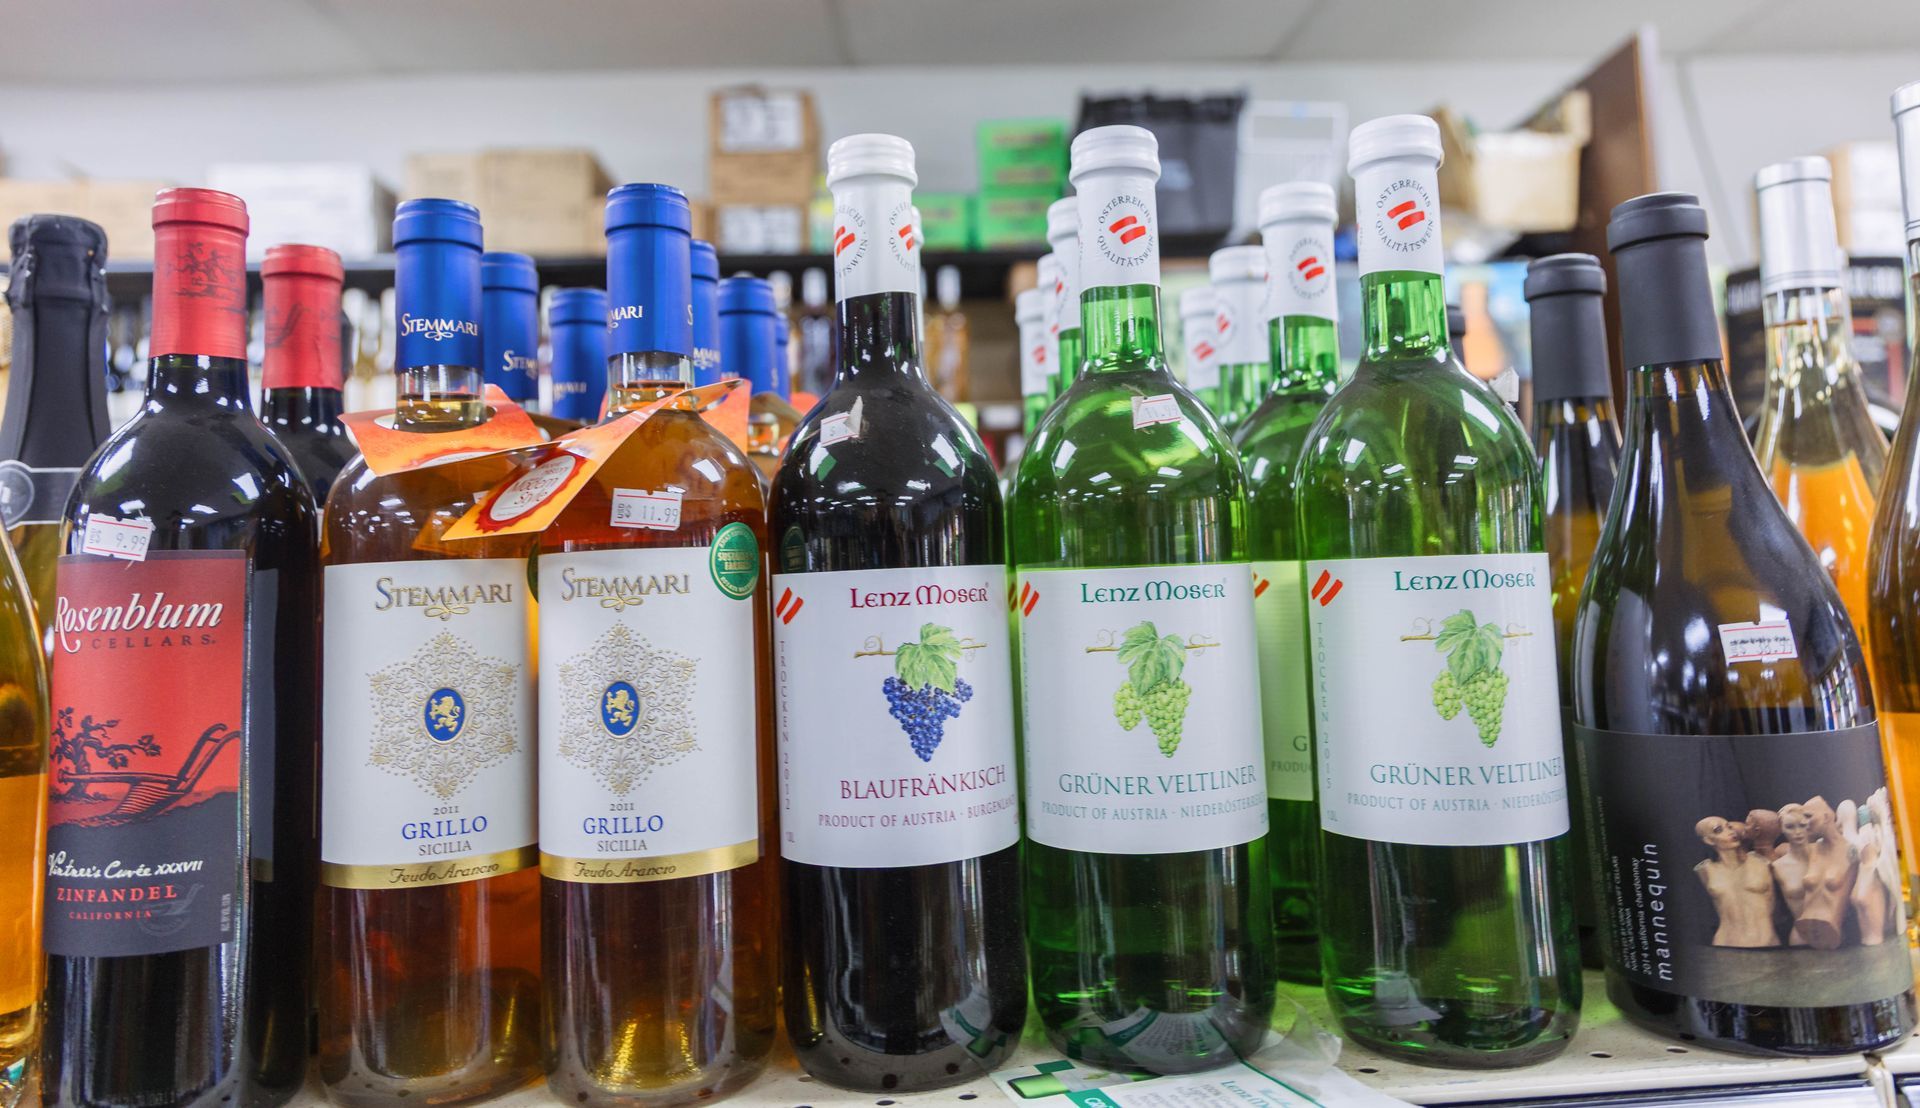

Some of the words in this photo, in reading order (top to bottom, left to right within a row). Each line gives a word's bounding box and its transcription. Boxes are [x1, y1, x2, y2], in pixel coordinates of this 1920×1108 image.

[642, 506, 679, 524] 11.99
[116, 532, 147, 552] 9.99
[375, 576, 513, 620] STEMMARI
[561, 567, 691, 611] STEMMARI
[54, 592, 224, 653] Rosenblum
[840, 765, 1006, 799] BLAUFRÄNKISCH
[1058, 772, 1154, 795] GRÜNER
[1158, 765, 1257, 794] VELTLINER
[1370, 763, 1475, 786] GRÜNER
[432, 806, 460, 815] 2011
[609, 803, 635, 811] 2011
[1041, 801, 1087, 819] PRODUCT
[1092, 807, 1108, 820] OF
[1112, 808, 1168, 820] AUSTRIA
[1347, 793, 1404, 810] PRODUCT
[1409, 798, 1427, 811] OF
[1433, 798, 1490, 812] AUSTRIA
[402, 816, 488, 840] GRILLO
[583, 815, 664, 835] GRILLO
[818, 814, 875, 828] PRODUCT
[880, 815, 897, 827] OF
[902, 812, 957, 826] AUSTRIA
[418, 840, 472, 856] SICILIA
[597, 840, 648, 852] SICILIA
[154, 861, 204, 875] XXXVII
[1632, 857, 1645, 908] chardonnay
[57, 884, 178, 903] ZINFANDEL
[69, 911, 152, 921] CALIFORNIA
[1640, 843, 1673, 981] mannequin
[1637, 910, 1649, 950] california
